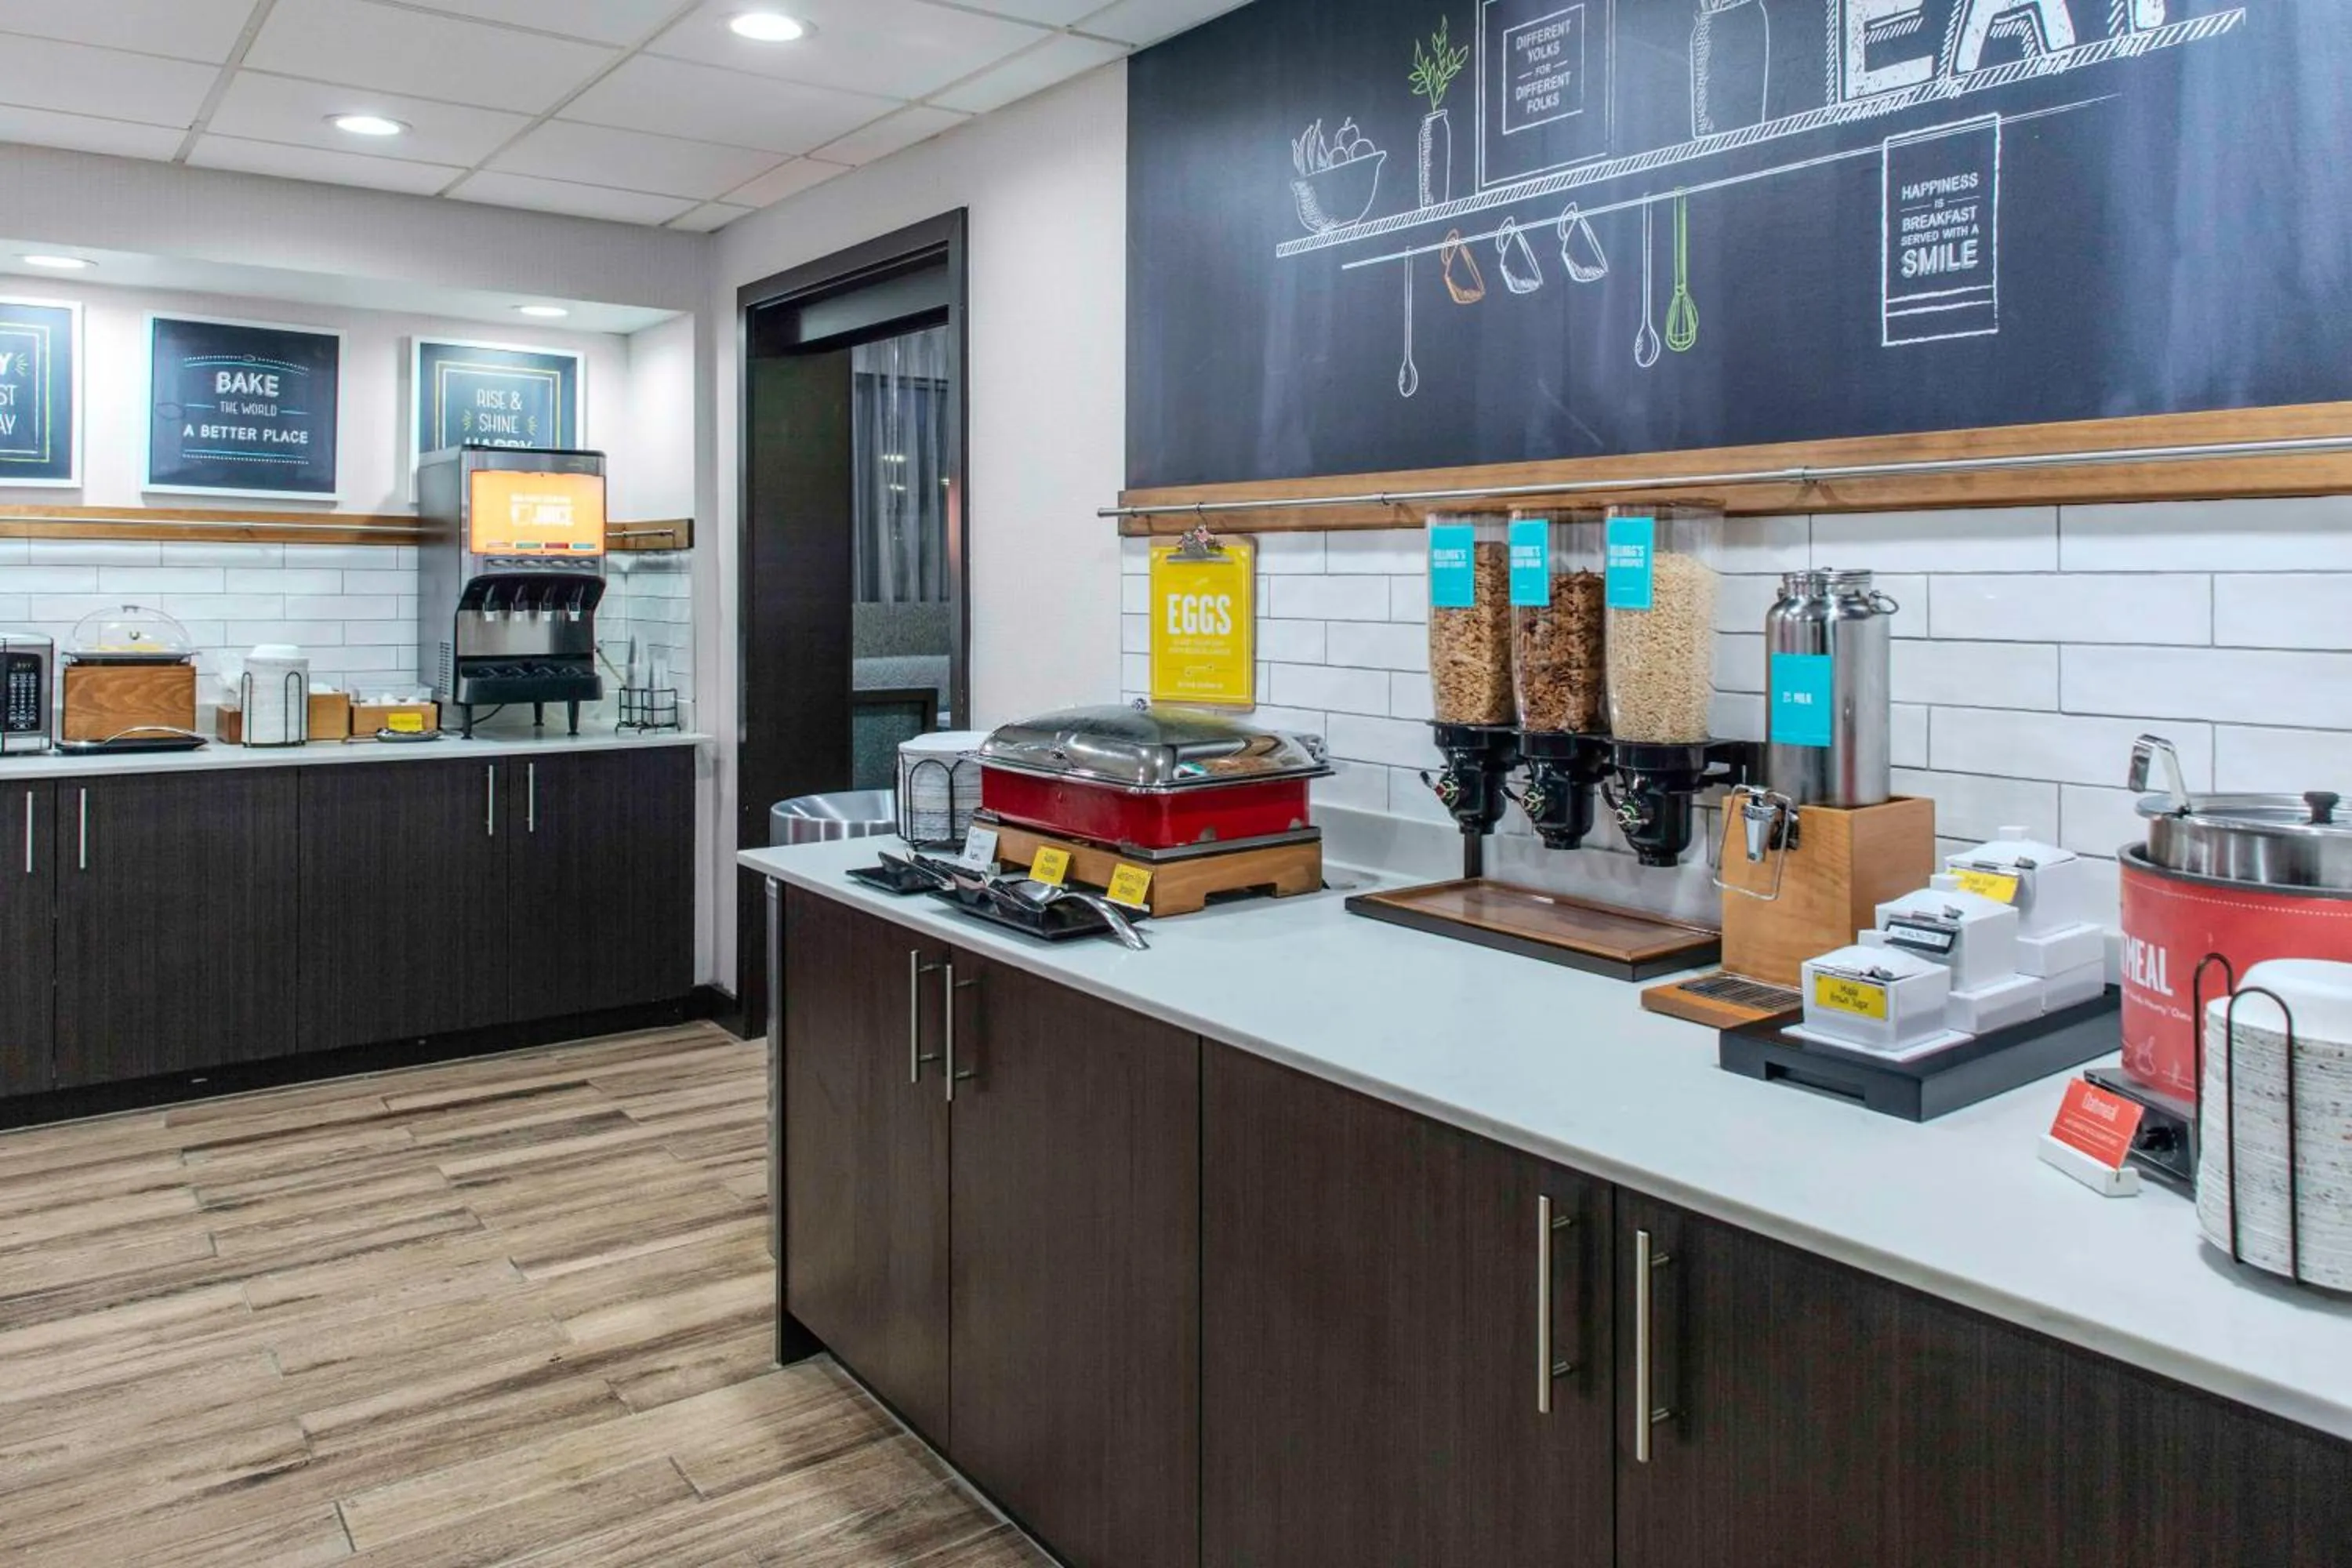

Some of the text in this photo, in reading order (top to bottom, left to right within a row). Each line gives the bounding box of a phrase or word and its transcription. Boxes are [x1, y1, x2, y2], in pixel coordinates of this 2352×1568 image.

[1515, 19, 1571, 50] DIFFERENT
[1528, 40, 1559, 63] YOLKS
[1535, 64, 1551, 76] FOR
[1515, 71, 1571, 100] DIFFERENT
[1526, 92, 1559, 114] FOLKS
[1901, 172, 1978, 200] HAPPINESS
[1934, 198, 1944, 209] IS
[1901, 205, 1977, 232] BREAKFAST
[1900, 223, 1980, 246] SERVED WITH A
[1901, 239, 1979, 278] SMILE
[216, 371, 279, 397] BAKE
[220, 401, 277, 417] THE WORLD
[477, 389, 522, 411] RISE &
[183, 423, 309, 445] A BETTER PLACE
[479, 413, 521, 434] SHINE
[1167, 593, 1232, 635] EGGS
